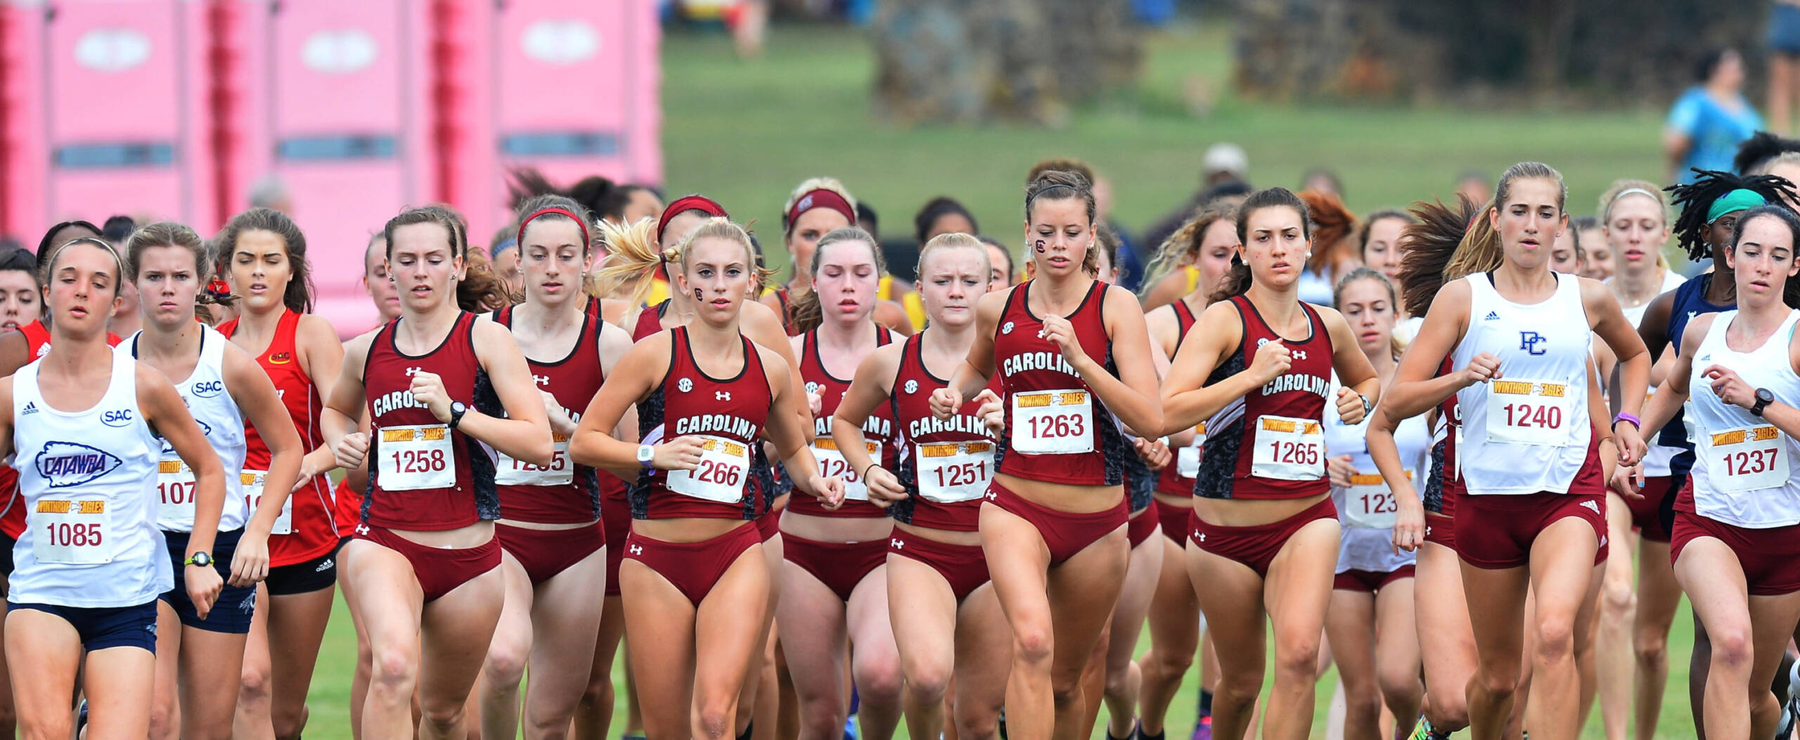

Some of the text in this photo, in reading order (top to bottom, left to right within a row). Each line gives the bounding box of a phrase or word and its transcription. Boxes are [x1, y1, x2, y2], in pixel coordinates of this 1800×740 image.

[1519, 331, 1547, 355] PC
[270, 352, 290, 360] SAC
[195, 380, 222, 394] SAC
[1262, 373, 1330, 400] CAROLINA
[1494, 381, 1565, 397] WINTHROP EAGLES
[1018, 391, 1085, 407] WINTHROP EAGLES
[105, 409, 132, 422] SAC
[676, 414, 757, 441] CAROLINA
[1028, 413, 1084, 439] 1263
[1503, 403, 1562, 429] 1240
[1713, 426, 1779, 446] WINTHROP EAGLES
[392, 449, 446, 473] 1258
[1271, 440, 1318, 465] 1265
[1723, 447, 1778, 476] 1237
[44, 453, 107, 477] CATAWBA
[821, 458, 859, 483] 125
[934, 460, 986, 487] 1251
[157, 481, 195, 504] 107
[1360, 493, 1398, 514] 123
[47, 522, 102, 546] 1085
